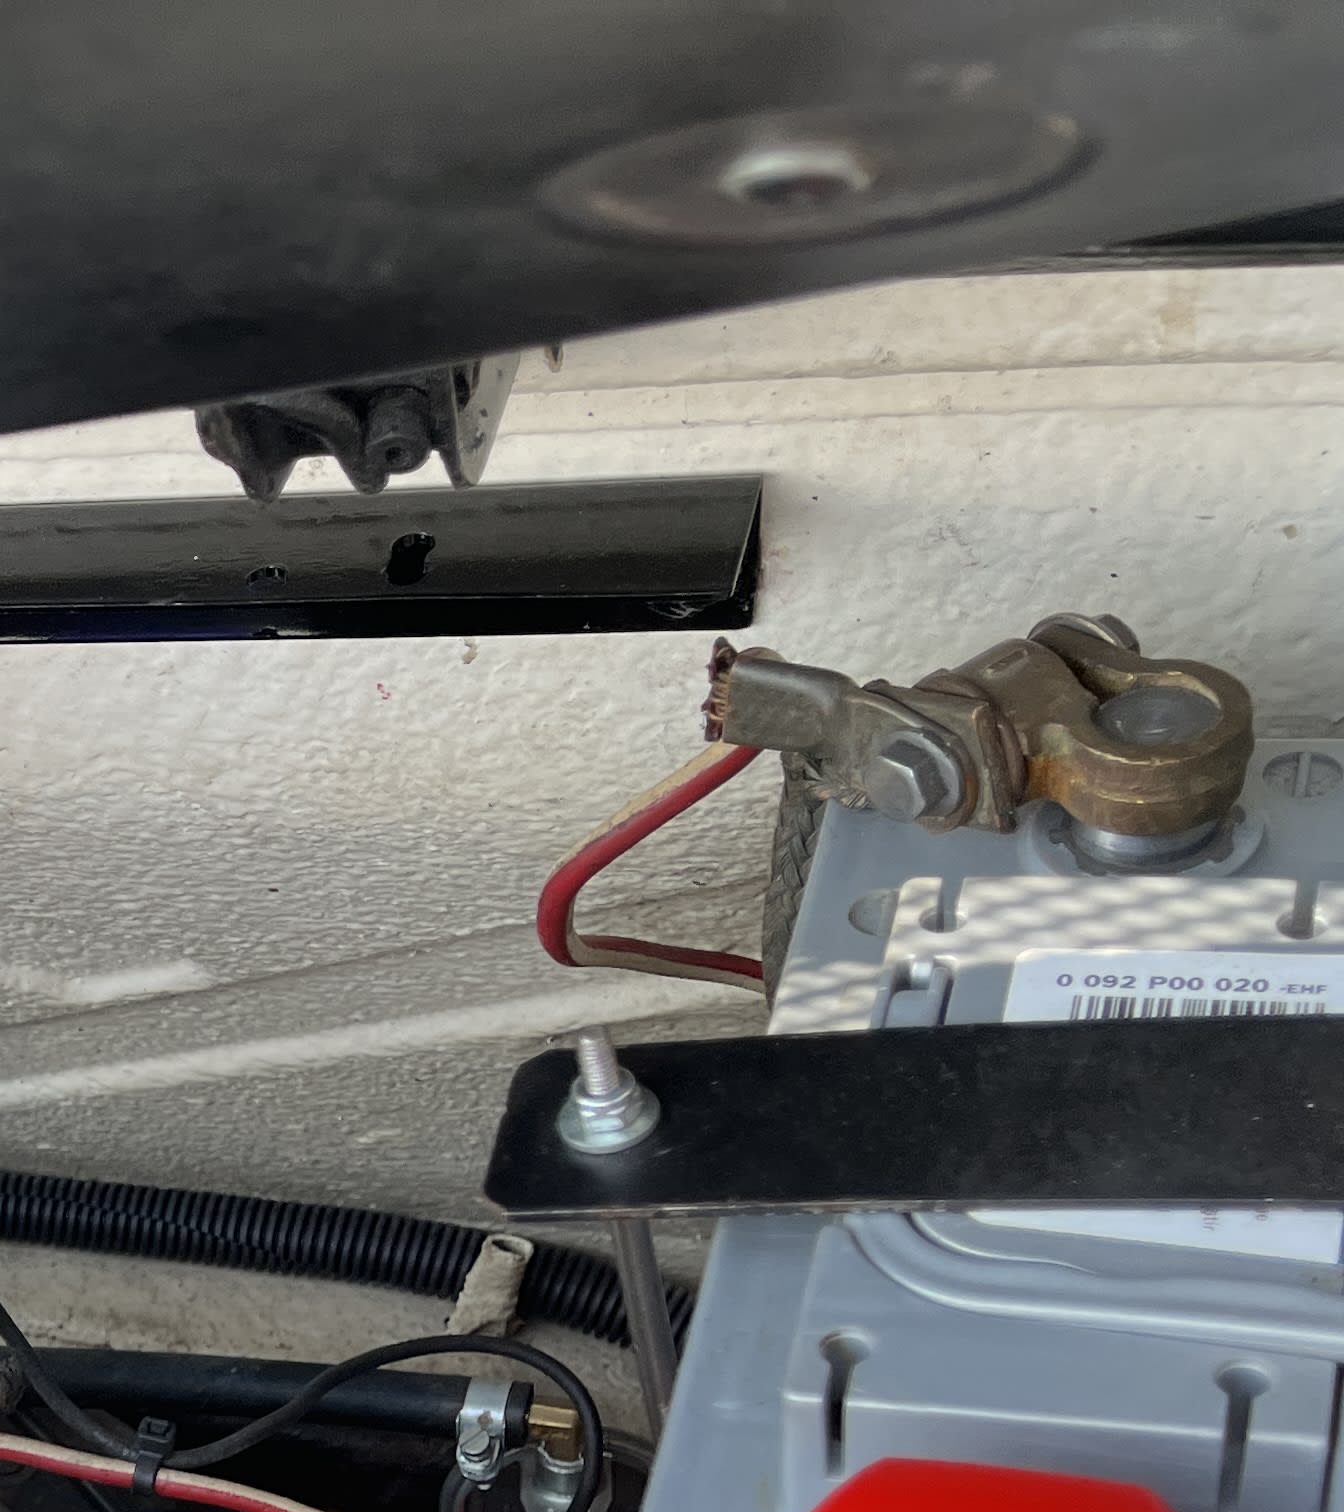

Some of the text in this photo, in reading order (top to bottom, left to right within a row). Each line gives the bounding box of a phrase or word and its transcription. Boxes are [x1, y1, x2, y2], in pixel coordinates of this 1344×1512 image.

[1056, 973, 1073, 988] 0
[1083, 974, 1137, 990] 092
[1148, 976, 1204, 991] P00
[1215, 977, 1269, 993] 020
